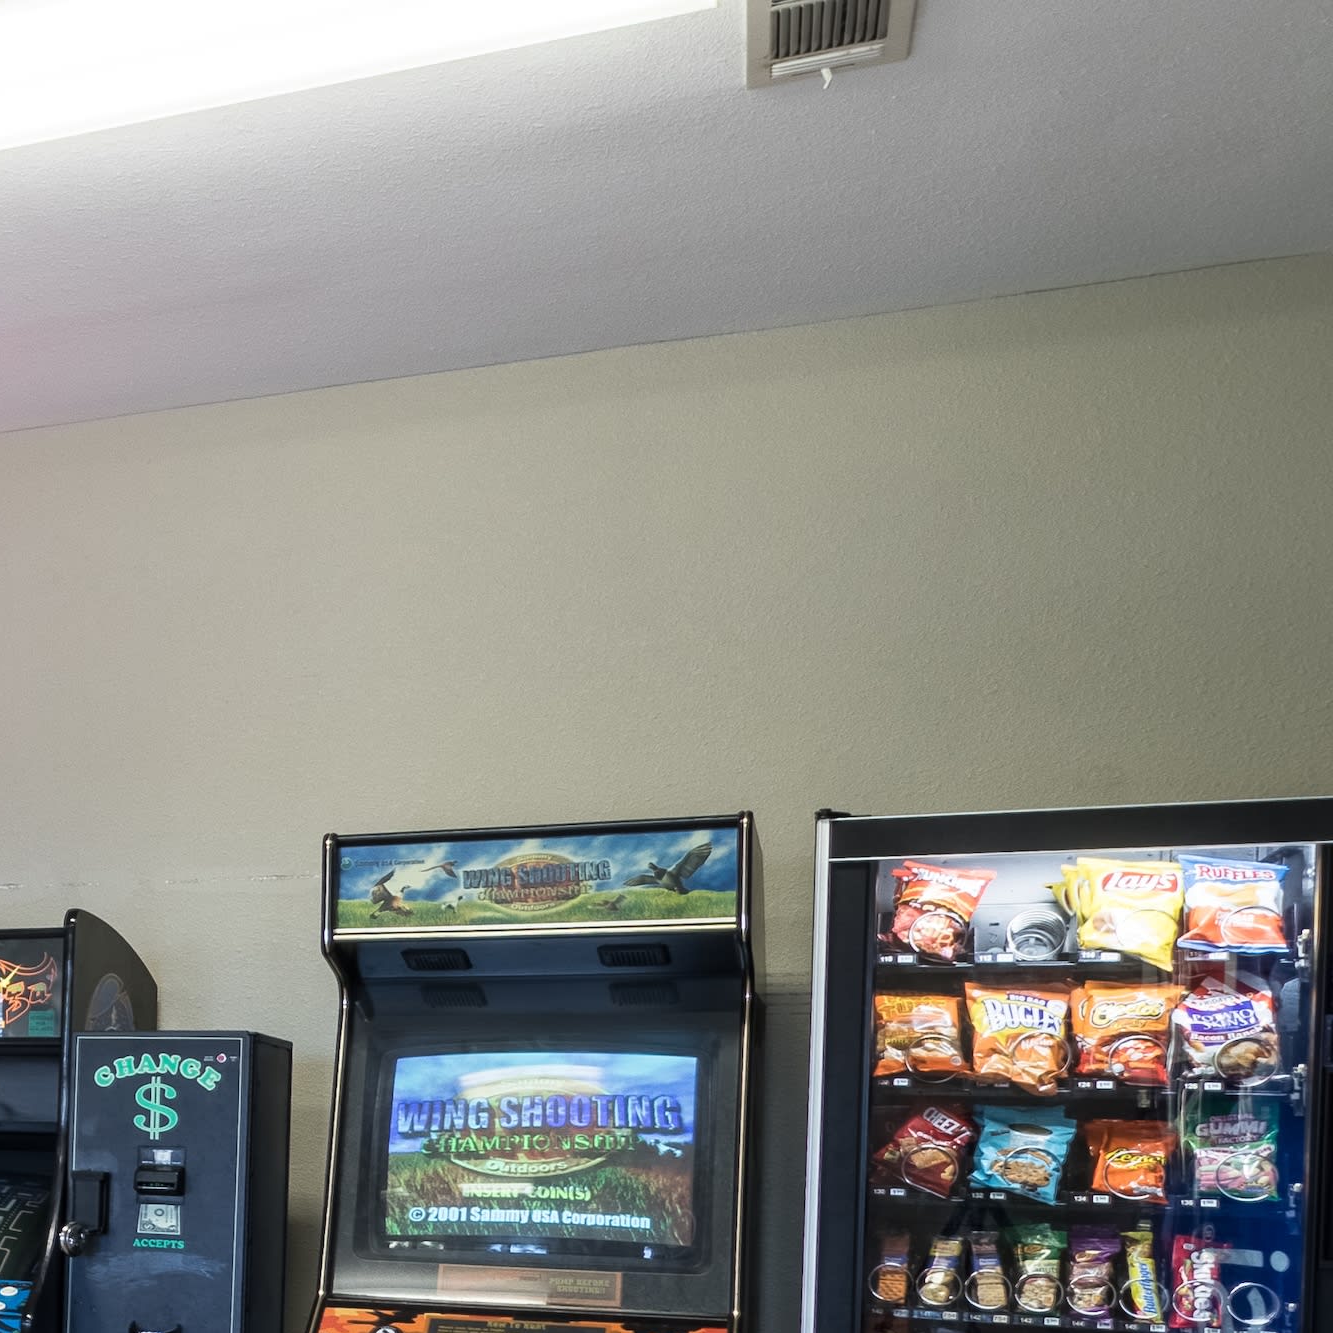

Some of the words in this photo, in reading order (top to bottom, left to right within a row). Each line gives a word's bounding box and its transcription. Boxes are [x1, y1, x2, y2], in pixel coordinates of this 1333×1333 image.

[462, 868, 513, 889] WING
[516, 860, 612, 886] SHOOTING
[1196, 864, 1276, 880] RUFFLES
[478, 882, 594, 903] CHAMPIONSHIP
[510, 902, 555, 912] Outdoors
[982, 999, 1062, 1034] BUGLES
[1190, 1032, 1225, 1041] Bacon
[1228, 1025, 1264, 1040] Ranch
[94, 1053, 222, 1091] CHANGE
[396, 1096, 490, 1134] WING
[499, 1094, 683, 1133] SHOOTING
[1195, 1120, 1268, 1137] GUMMI
[421, 1132, 643, 1156] CHAMPIONSHIP
[485, 1159, 568, 1173] Outdoors
[462, 1184, 527, 1199] INSERT
[528, 1184, 592, 1201] COIN(S)
[427, 1206, 468, 1222] 2001
[469, 1207, 529, 1225] Sammy
[531, 1209, 561, 1223] USA
[562, 1211, 651, 1229] Corporation
[133, 1238, 185, 1249] ACCEPTS
[1137, 1261, 1158, 1314] Butterfinger
[1190, 1250, 1215, 1321] Skittles
